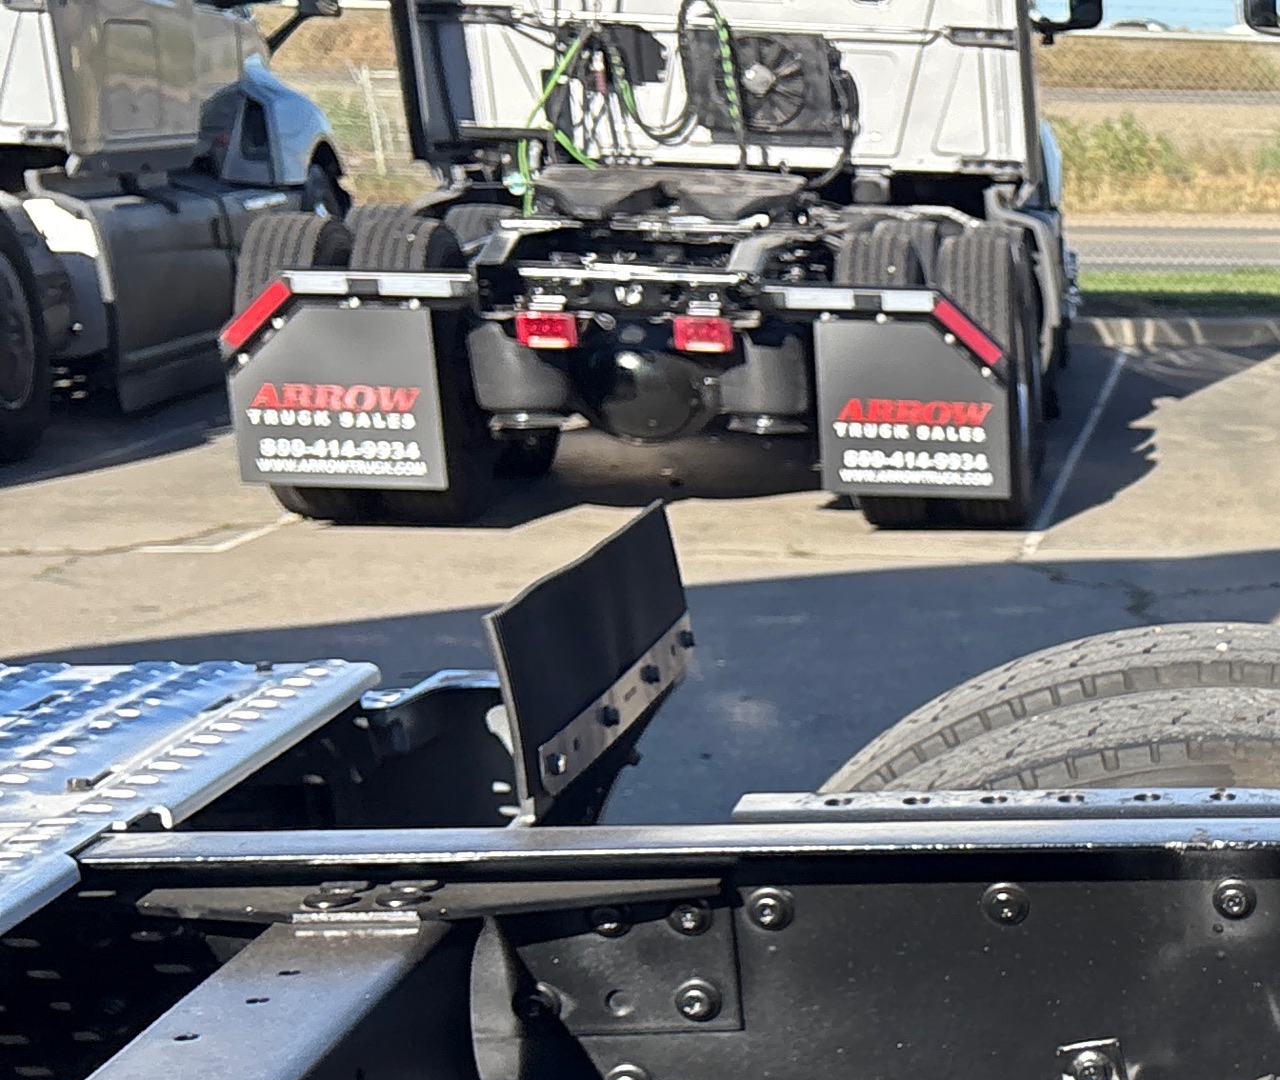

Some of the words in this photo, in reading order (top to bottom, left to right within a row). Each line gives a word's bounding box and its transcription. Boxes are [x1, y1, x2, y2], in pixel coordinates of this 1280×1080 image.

[250, 383, 420, 412] ARROW
[246, 409, 331, 427] TRUCK
[339, 412, 416, 430] SALES
[834, 398, 994, 426] ARROW
[832, 422, 910, 439] TRUCK
[916, 425, 986, 443] SALES
[255, 458, 427, 476] WWW.ARROWTRUCK.COM
